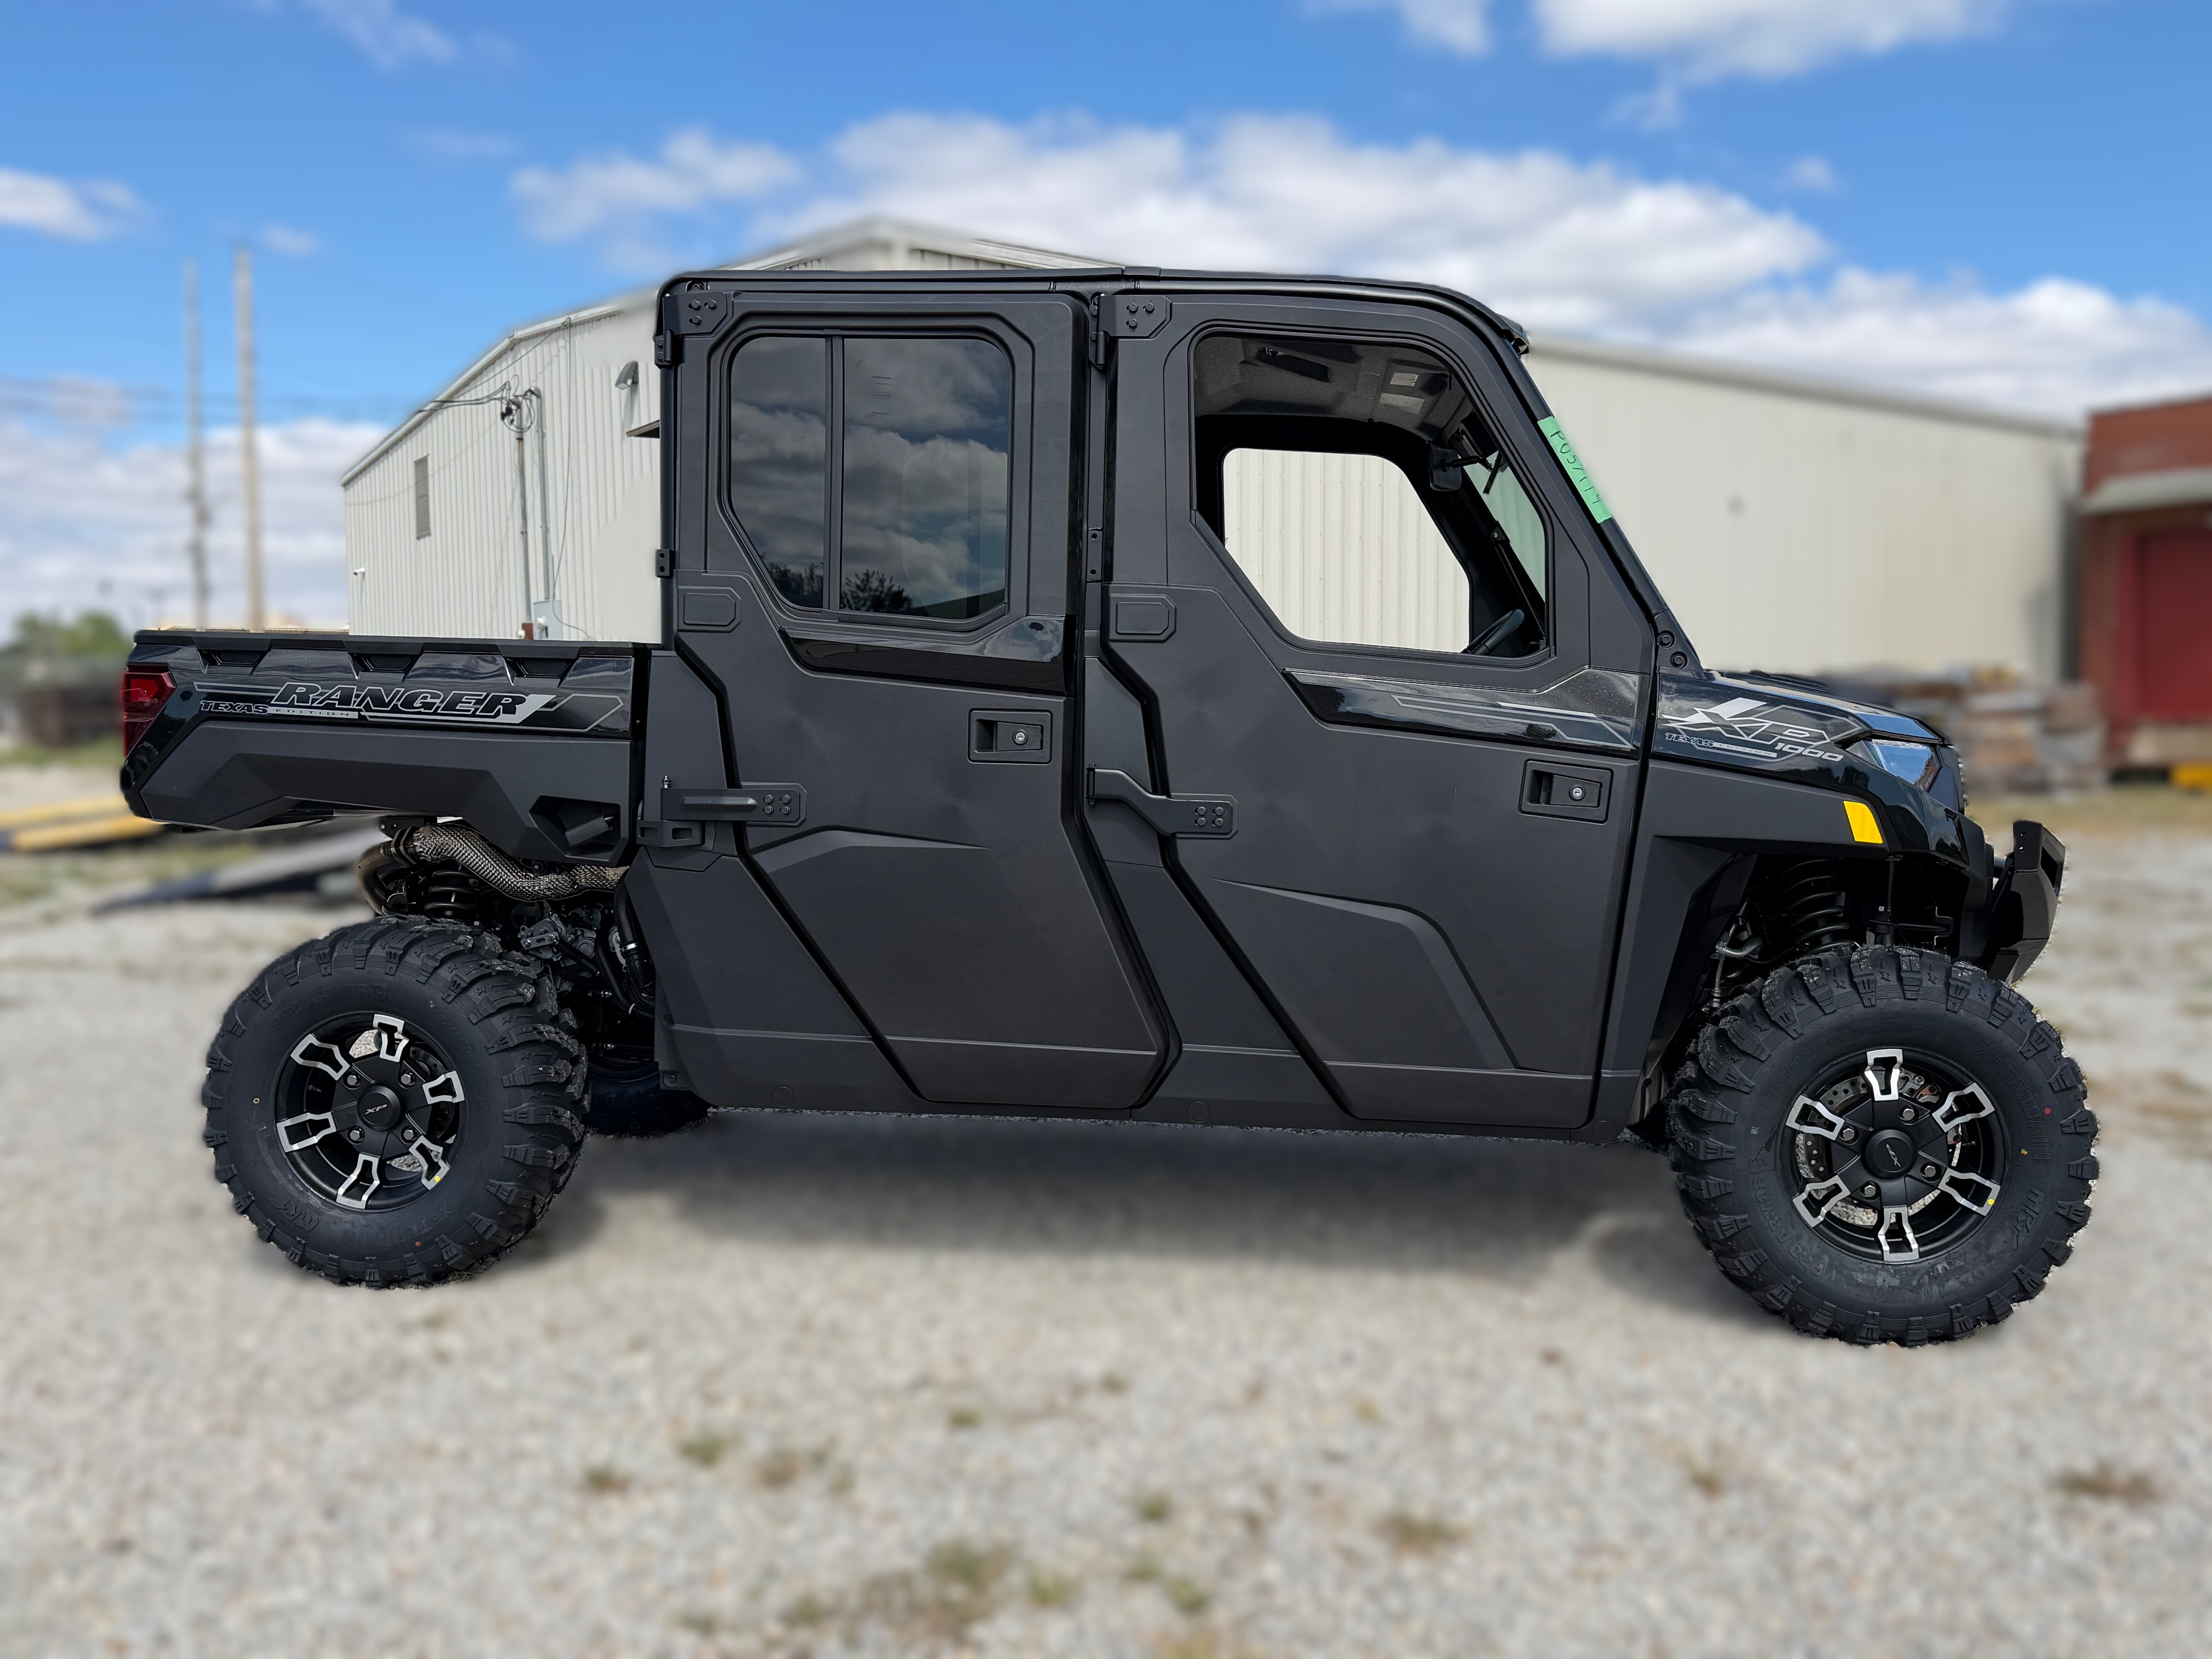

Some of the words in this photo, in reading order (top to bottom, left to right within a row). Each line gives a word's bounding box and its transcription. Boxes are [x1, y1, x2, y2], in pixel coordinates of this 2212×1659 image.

[200, 701, 270, 715] TEXAS
[275, 708, 350, 716] EDITION
[270, 682, 527, 716] RANGER
[1662, 697, 1831, 745] XP
[1665, 732, 1716, 748] TEXAS
[1774, 742, 1844, 762] 1000
[1973, 1040, 2051, 1160] X-TERRAIN
